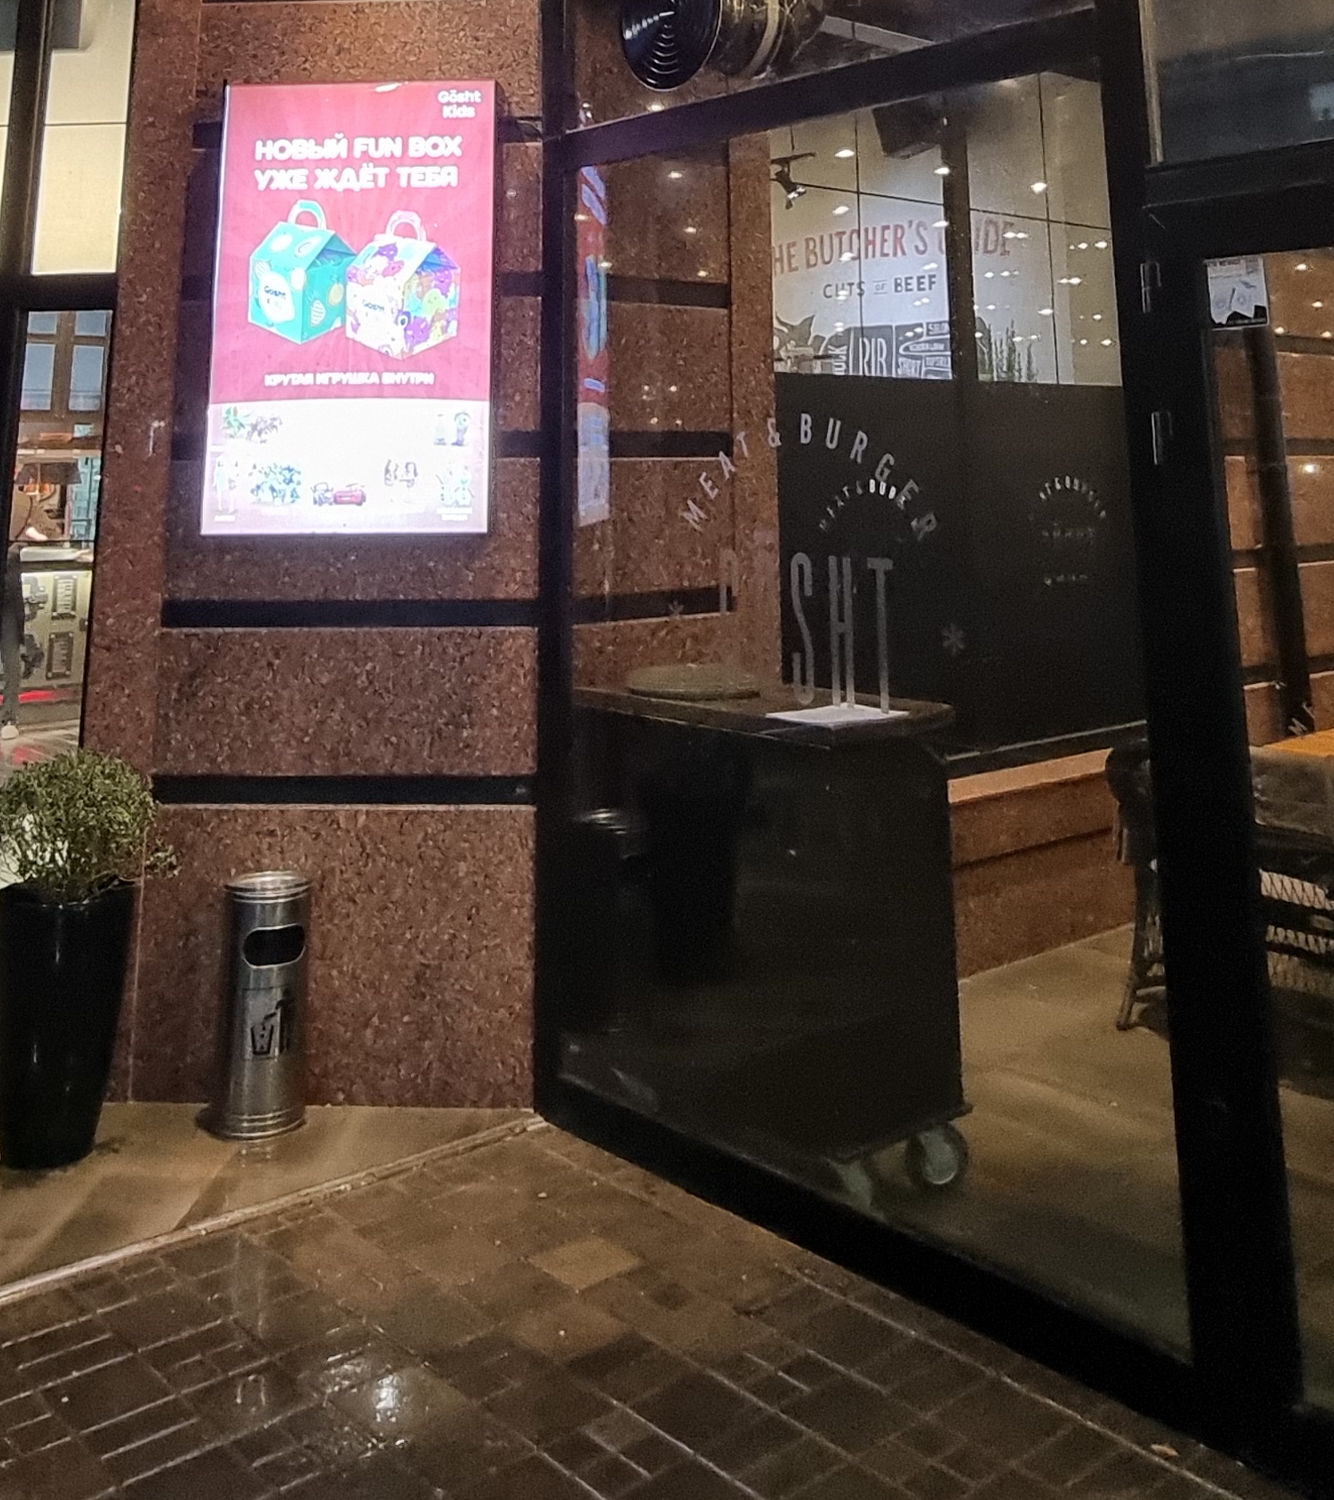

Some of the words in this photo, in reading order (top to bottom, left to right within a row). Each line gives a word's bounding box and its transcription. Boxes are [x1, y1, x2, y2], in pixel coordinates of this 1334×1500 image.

[442, 104, 476, 119] Kids
[254, 132, 349, 161] НОВЫЙ
[353, 136, 403, 159] FUN
[407, 135, 463, 158] BOX
[254, 167, 309, 191] УЖЕ
[313, 162, 390, 192] ЖДЁТ
[396, 165, 459, 188] ТЕБЯ
[771, 240, 800, 275] HE
[804, 219, 928, 270] BUTCHER'S
[893, 274, 937, 294] BEEF
[679, 430, 748, 534] MEAT
[767, 417, 782, 448] &
[799, 412, 938, 542] BURGER
[720, 549, 894, 714] SHT
